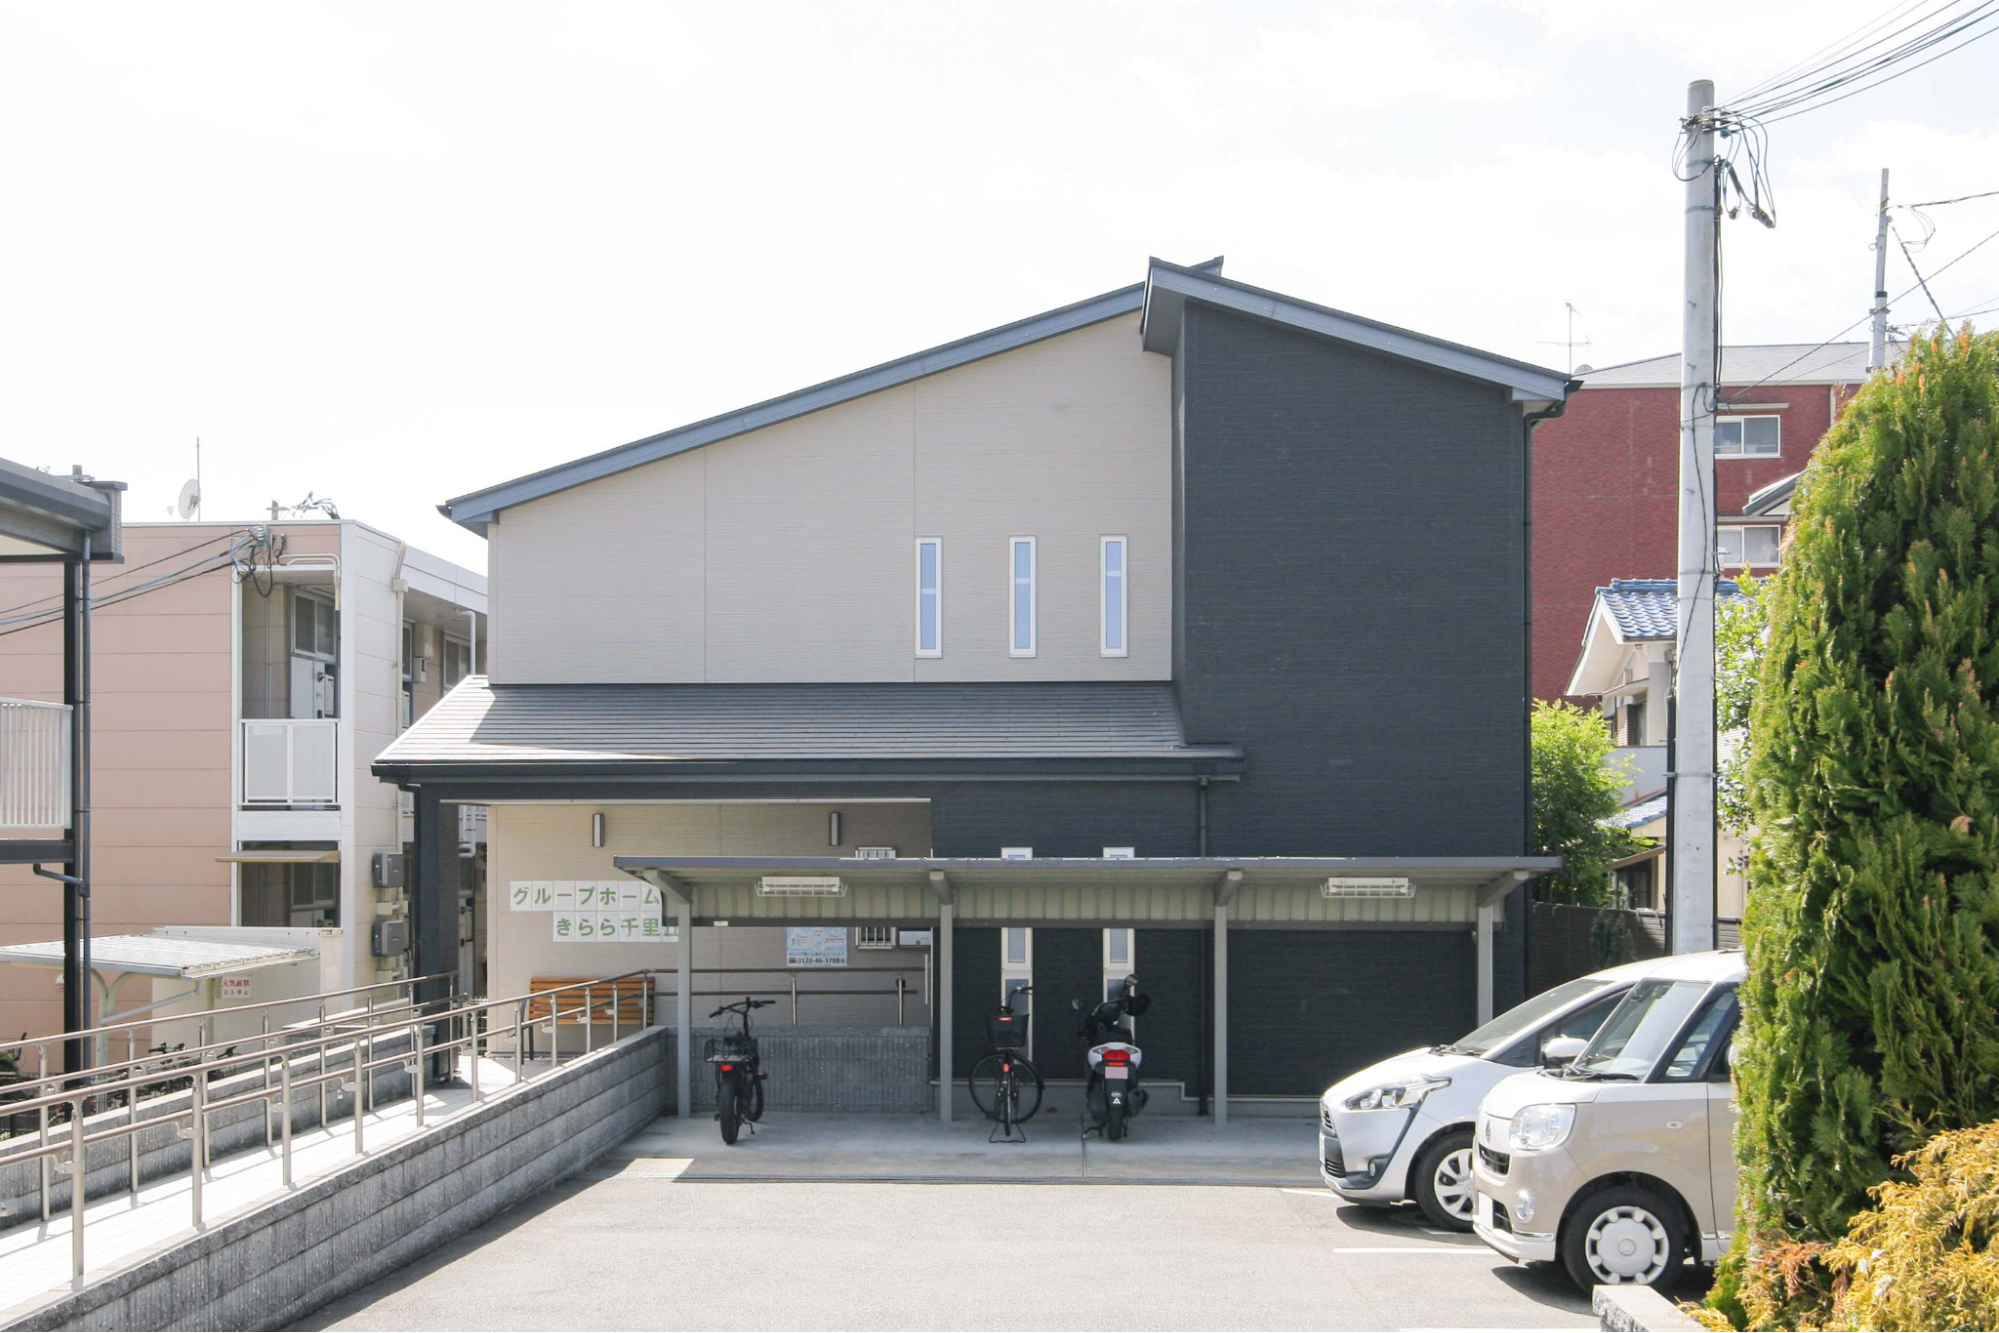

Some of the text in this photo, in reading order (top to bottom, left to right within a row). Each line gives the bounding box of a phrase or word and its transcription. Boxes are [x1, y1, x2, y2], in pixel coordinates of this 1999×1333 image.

[513, 886, 660, 906] グループホーム
